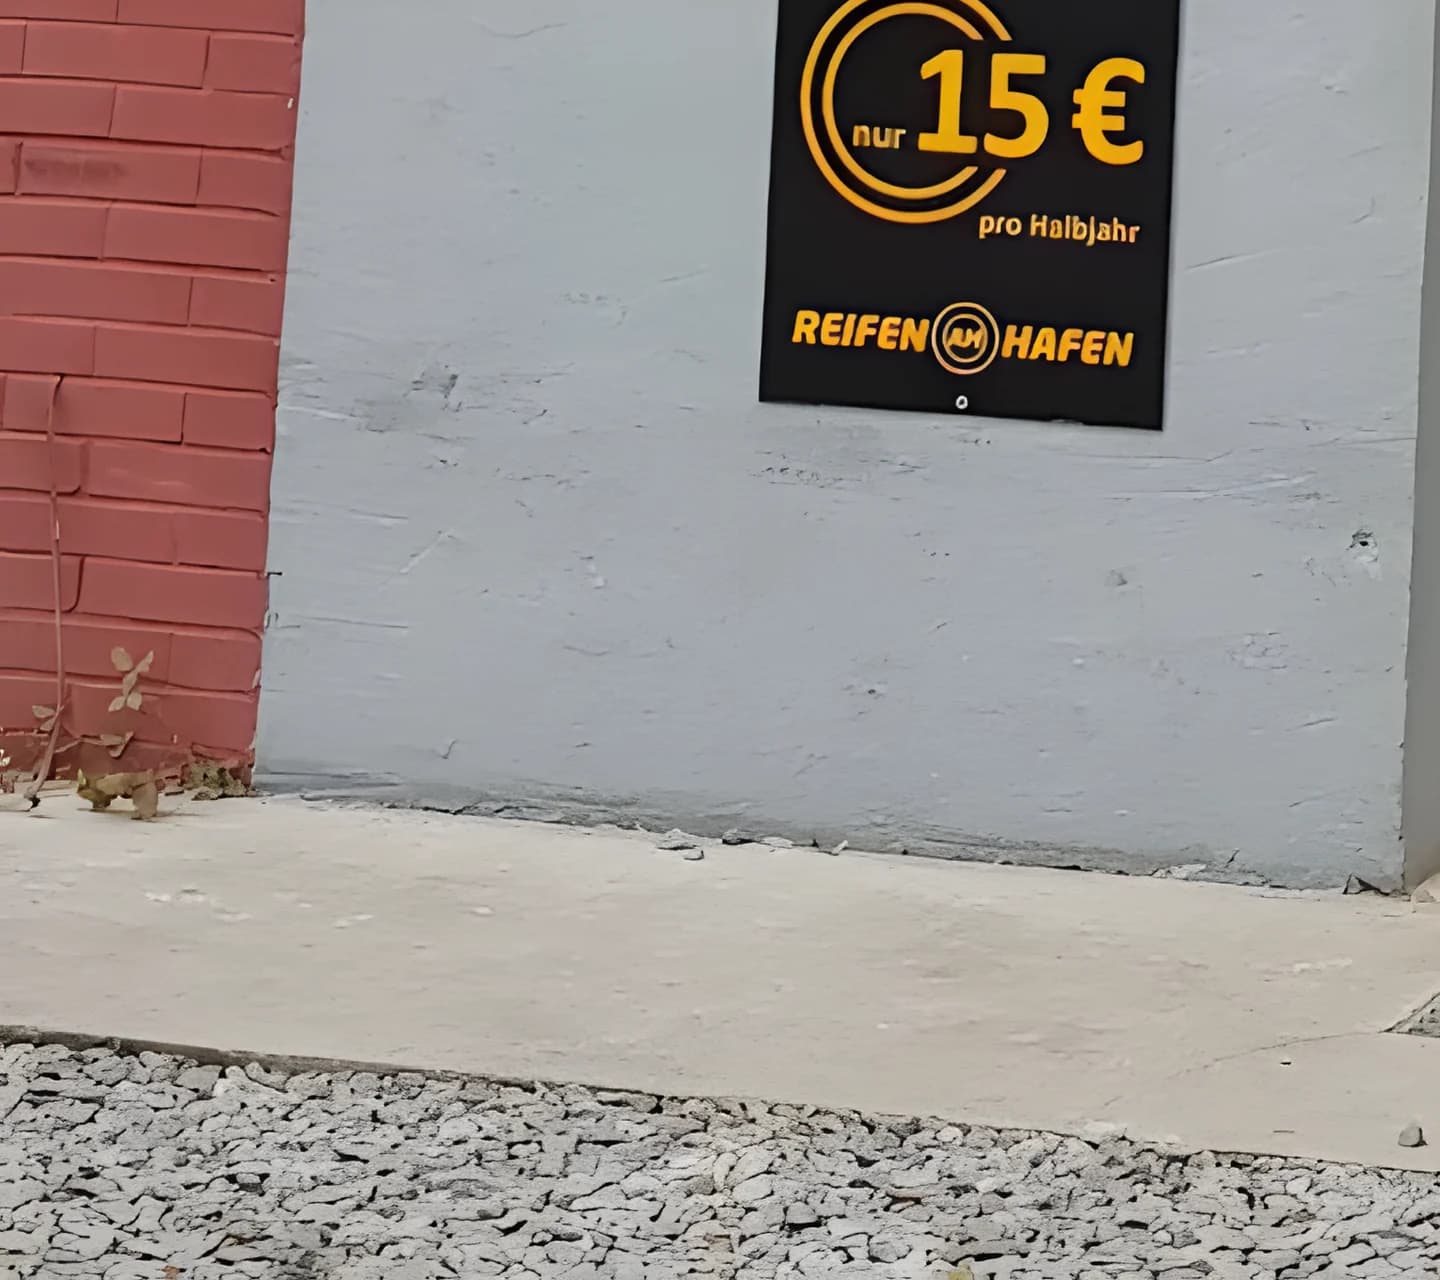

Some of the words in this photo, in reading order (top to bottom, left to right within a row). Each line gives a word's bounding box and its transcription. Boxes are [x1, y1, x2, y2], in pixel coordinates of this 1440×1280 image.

[853, 125, 906, 149] nur
[918, 50, 1048, 158] 15
[1072, 58, 1145, 165] €
[979, 216, 1022, 239] pro
[1030, 214, 1140, 246] Halbjahr
[792, 310, 929, 352] REIFEN
[1002, 325, 1133, 366] HAFEN
